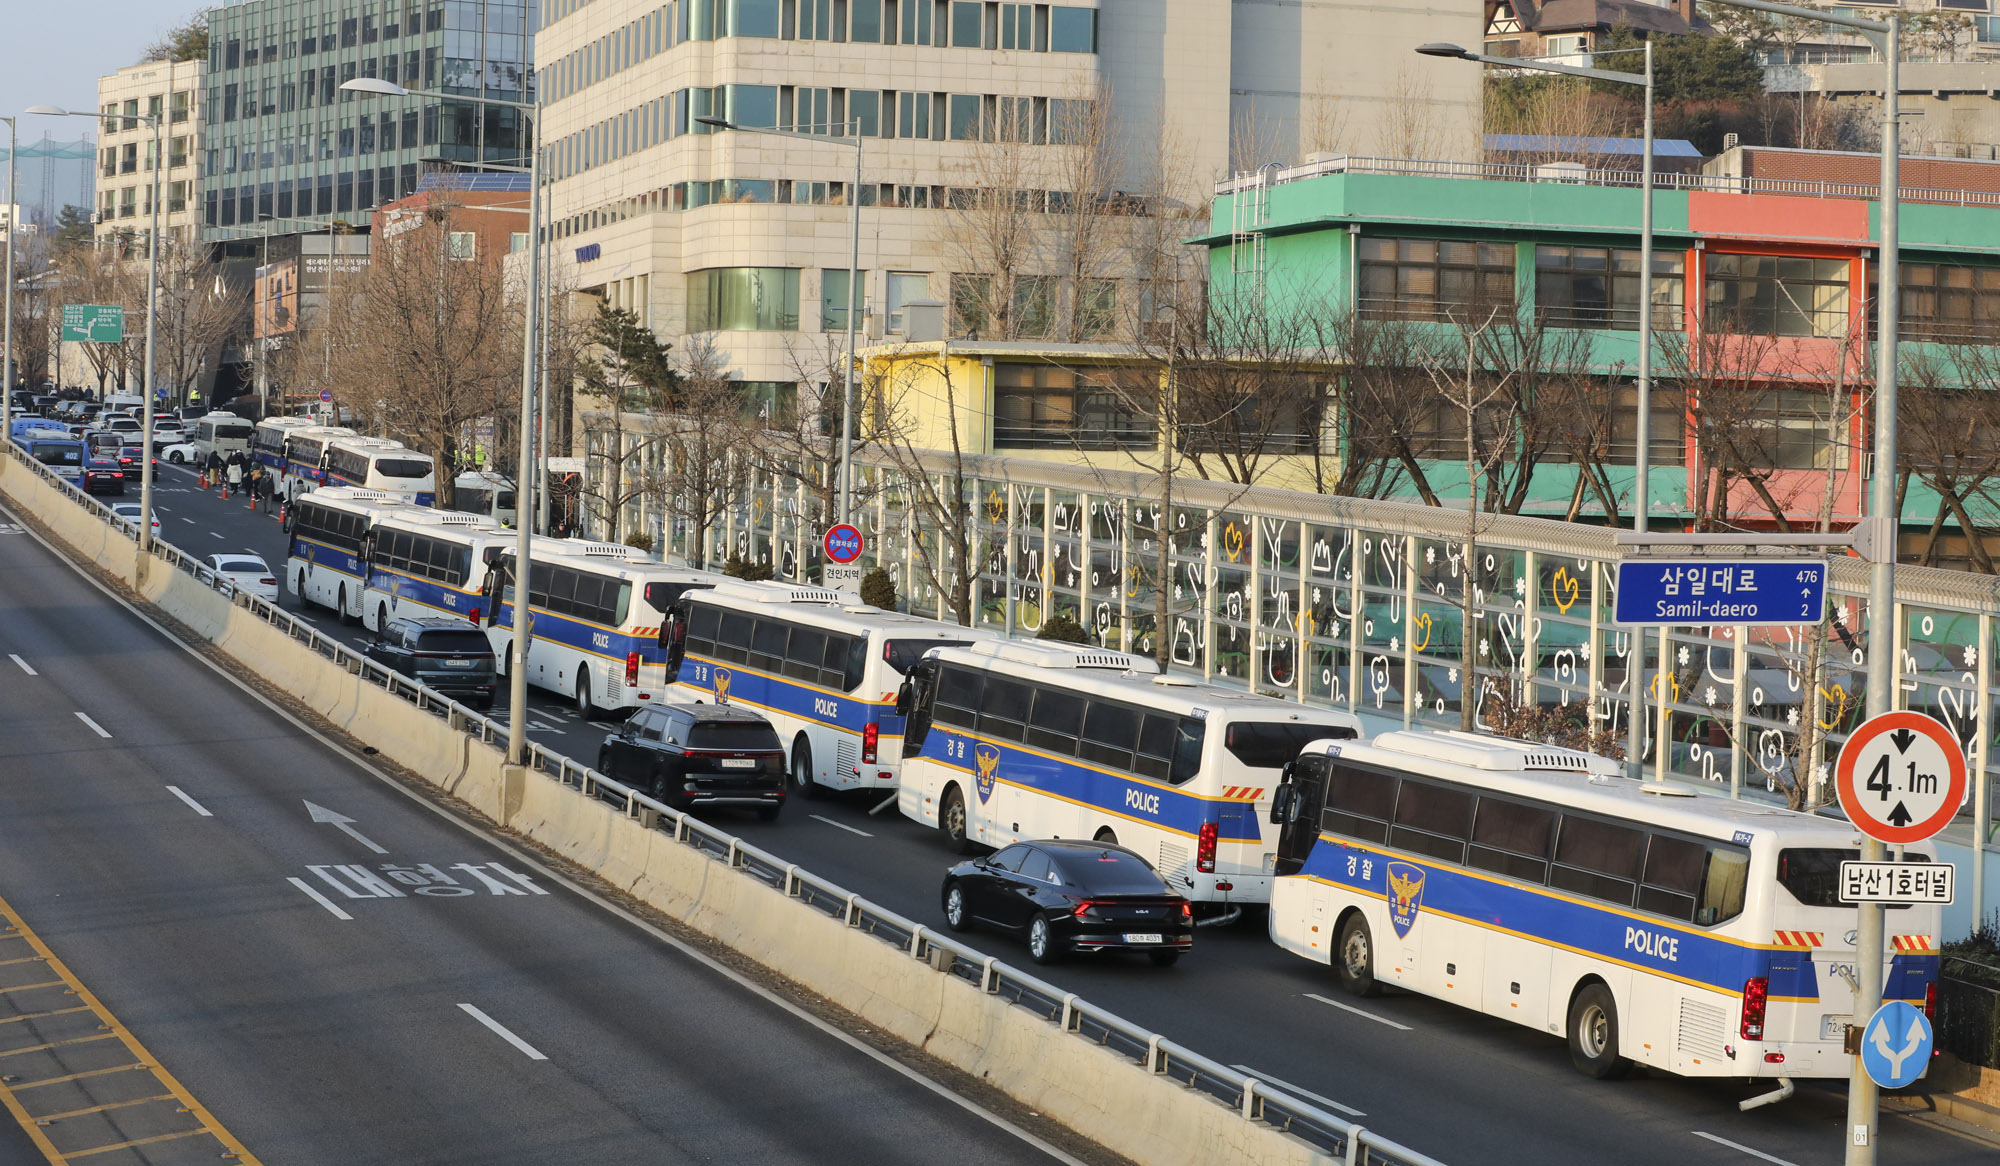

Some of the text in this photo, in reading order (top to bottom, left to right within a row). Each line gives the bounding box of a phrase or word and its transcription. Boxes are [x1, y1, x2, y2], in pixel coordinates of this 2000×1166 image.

[65, 452, 78, 460] 402
[826, 568, 859, 580] 견인지역
[1660, 567, 1758, 596] 삼일대로
[1796, 570, 1818, 583] 476
[1656, 600, 1758, 617] Samil-daero
[1800, 603, 1809, 616] 2
[592, 631, 609, 649] POLICE
[814, 697, 838, 718] POLICE
[1866, 754, 1937, 802] 4.1m
[1125, 788, 1160, 815] POLICE
[304, 862, 551, 899] 대형차
[1394, 915, 1410, 927] POLICE
[1624, 926, 1679, 962] POLICE
[1855, 1133, 1866, 1142] 01
